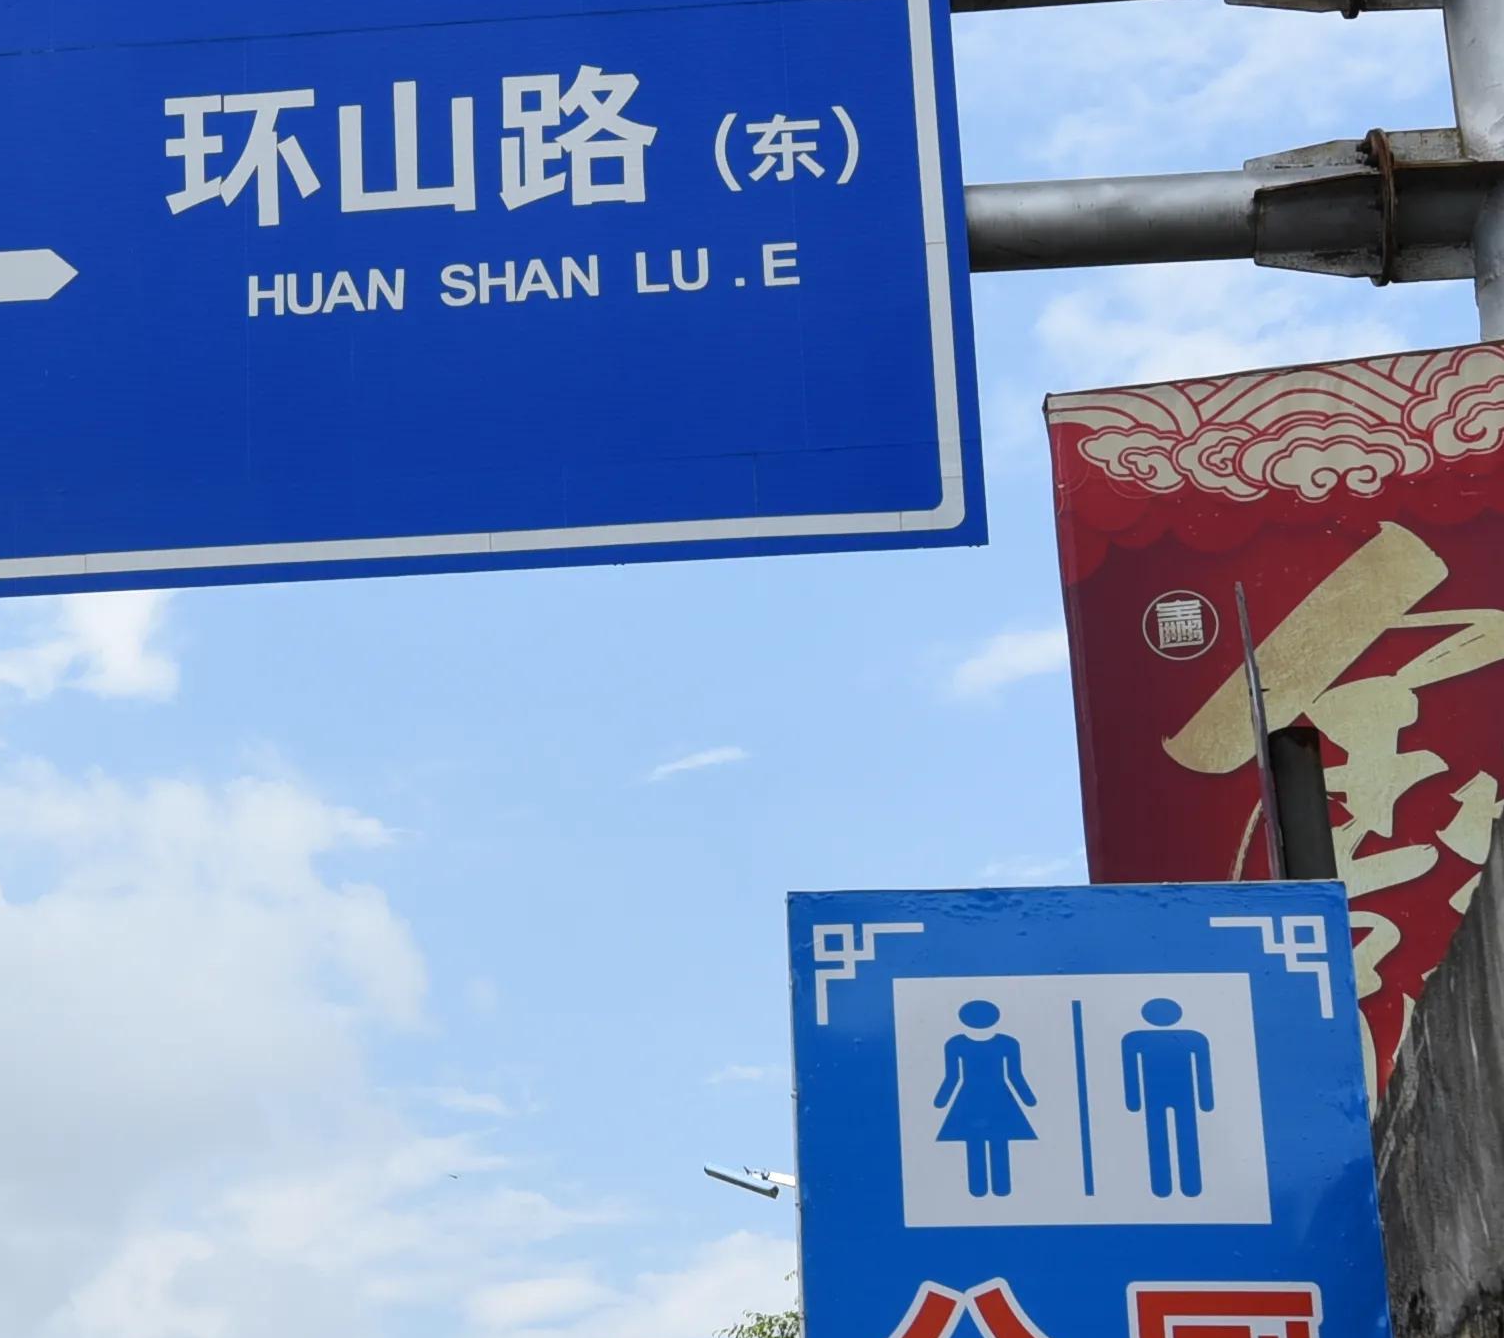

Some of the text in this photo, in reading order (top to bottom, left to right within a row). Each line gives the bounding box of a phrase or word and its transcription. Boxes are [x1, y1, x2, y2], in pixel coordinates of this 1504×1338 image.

[163, 63, 659, 228] 环山路
[247, 267, 406, 318] HUAN
[439, 253, 601, 308] SHAN
